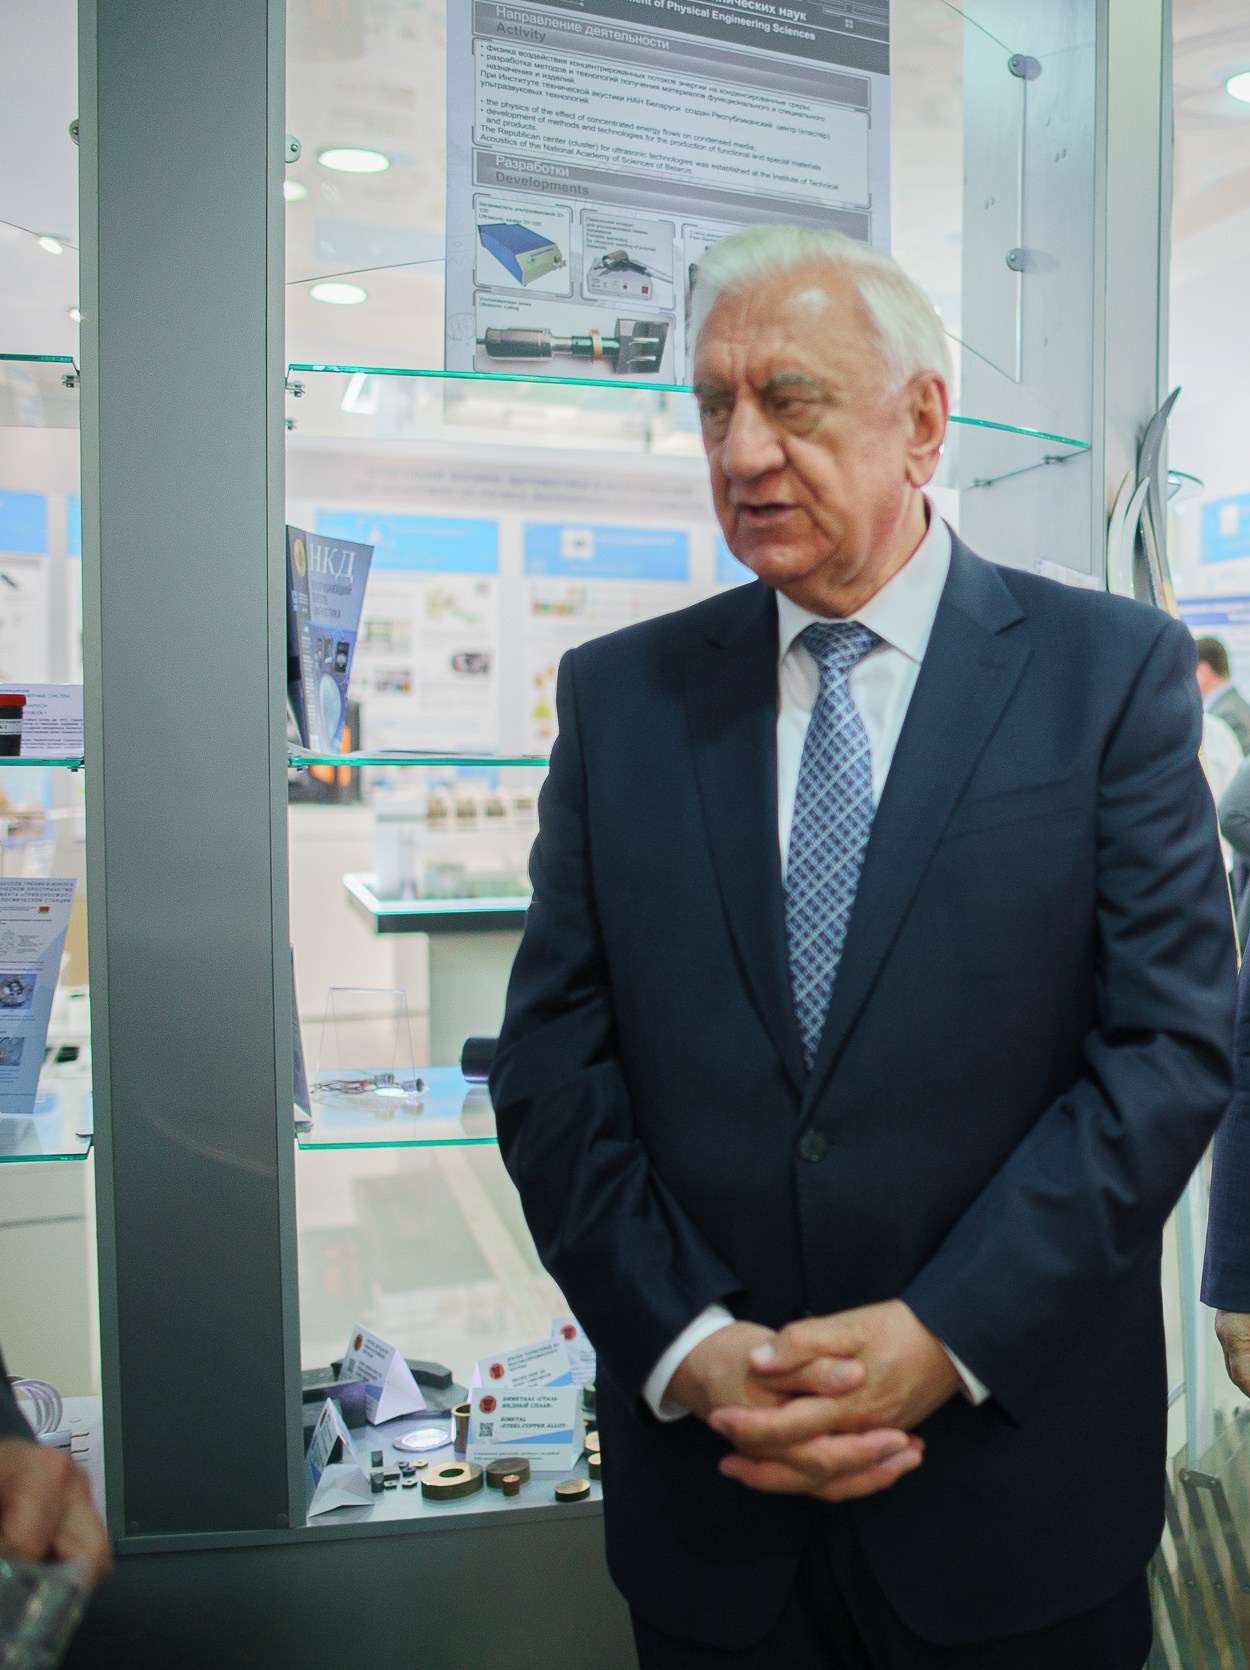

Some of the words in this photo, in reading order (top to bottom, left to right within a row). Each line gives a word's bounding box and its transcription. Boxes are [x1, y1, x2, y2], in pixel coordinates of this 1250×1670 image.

[496, 6, 582, 32] Направление
[584, 25, 670, 48] деятельности
[496, 22, 546, 42] Activity
[654, 0, 664, 8] of
[667, 1, 709, 17] Physical
[712, 10, 770, 32] Engineering
[772, 24, 815, 41] Sciences
[779, 8, 807, 21] наук
[486, 44, 516, 55] физика
[518, 51, 567, 64] воздействия
[486, 63, 532, 75] назначения
[542, 73, 576, 83] изделий.
[480, 80, 542, 95] ультразвуковых
[545, 91, 590, 103] технологий.
[480, 69, 496, 78] При
[498, 73, 539, 86] Институте
[542, 82, 589, 94] технической
[591, 91, 624, 100] акустики
[626, 96, 643, 104] НАН
[646, 99, 680, 111] Беларуси
[684, 108, 709, 116] создан
[486, 54, 531, 67] разработка
[534, 63, 566, 73] методов
[576, 70, 618, 82] технологий
[620, 78, 659, 89] получения
[662, 86, 705, 98] материалов
[486, 98, 498, 106] the
[500, 101, 529, 111] physics
[541, 107, 552, 115] the
[555, 110, 575, 119] effect
[586, 117, 633, 129] concentrated
[636, 125, 660, 135] energy
[662, 128, 680, 137] flows
[694, 135, 731, 146] condensed
[486, 117, 500, 125] and
[503, 120, 537, 130] products.
[486, 108, 535, 121] development
[547, 118, 579, 128] methods
[598, 126, 642, 139] technologies
[670, 140, 706, 150] production
[717, 146, 749, 158] functional
[766, 156, 788, 164] special
[792, 161, 820, 170] materials
[480, 133, 516, 145] Acoustics
[529, 141, 540, 149] the
[543, 143, 573, 154] National
[576, 149, 609, 161] Academy
[622, 156, 653, 167] Sciences
[665, 163, 693, 173] Belarus.
[481, 124, 495, 133] The
[497, 127, 540, 139] Republican
[542, 136, 565, 144] center
[568, 139, 598, 150] (cluster)
[612, 147, 646, 157] ultrasonic
[648, 153, 692, 165] technologies
[711, 164, 749, 175] established
[809, 179, 838, 190] Technical
[495, 155, 569, 176] Разработки
[495, 171, 588, 195] Developments
[309, 544, 356, 583] НКД
